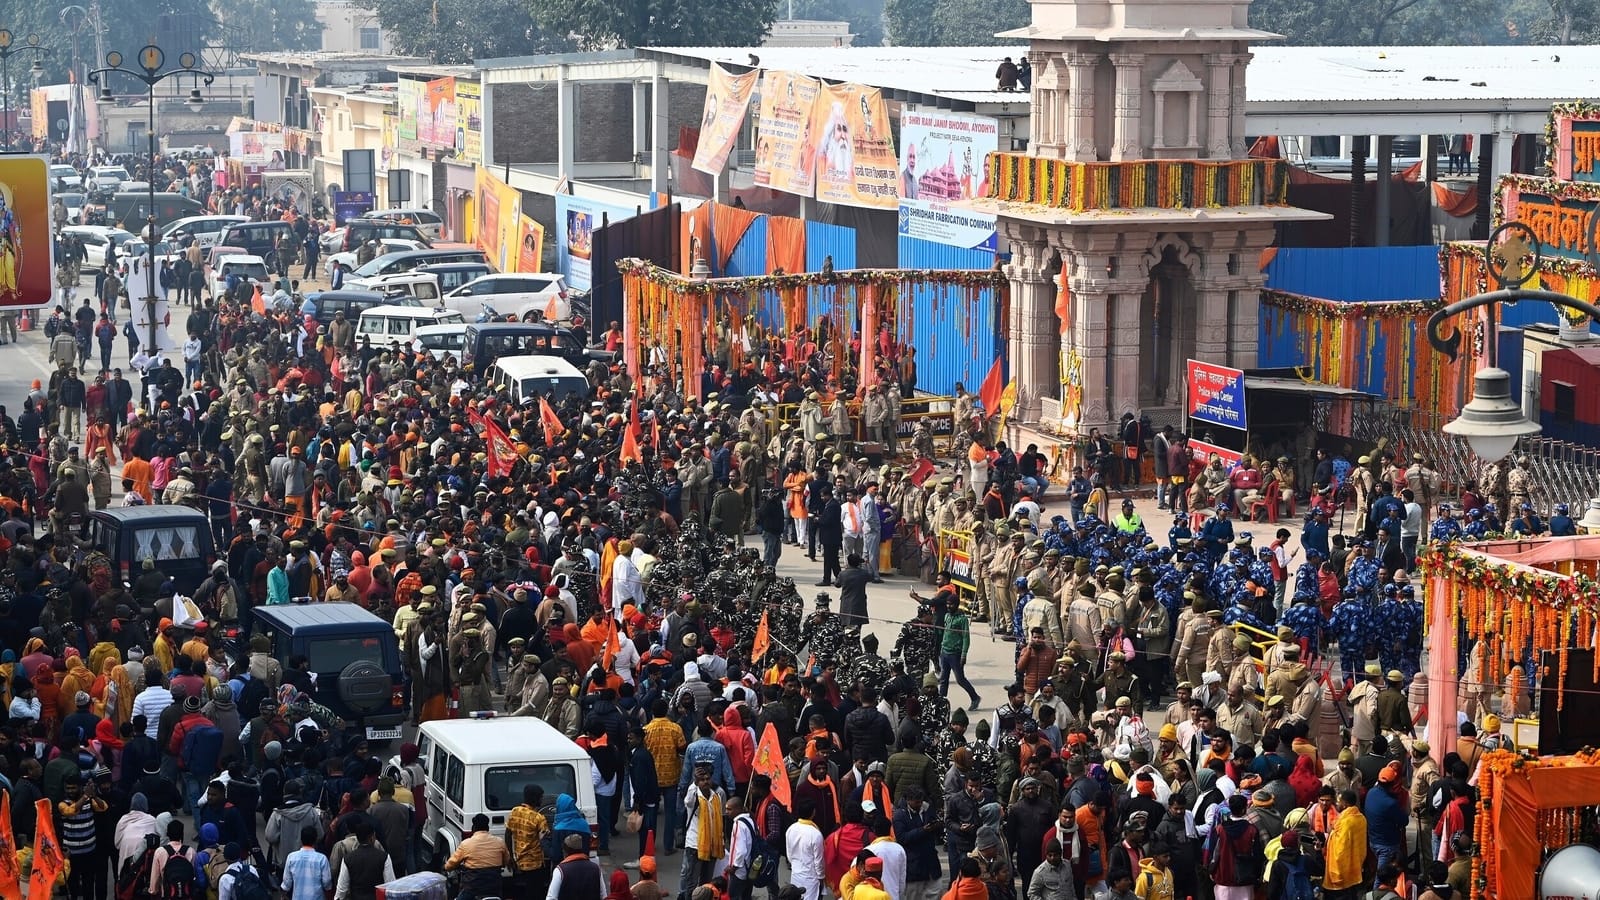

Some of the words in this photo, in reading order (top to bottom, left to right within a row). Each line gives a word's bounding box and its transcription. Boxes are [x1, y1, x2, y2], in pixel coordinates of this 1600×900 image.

[909, 115, 920, 125] SHRI
[921, 117, 933, 127] RAM
[934, 118, 948, 129] JANM
[971, 122, 996, 134] AYODHYA
[909, 207, 935, 219] SHRIDHAR
[935, 212, 969, 227] FABRICATION
[969, 218, 996, 231] COMPANY
[1198, 385, 1210, 397] Police
[1210, 388, 1220, 402] Help
